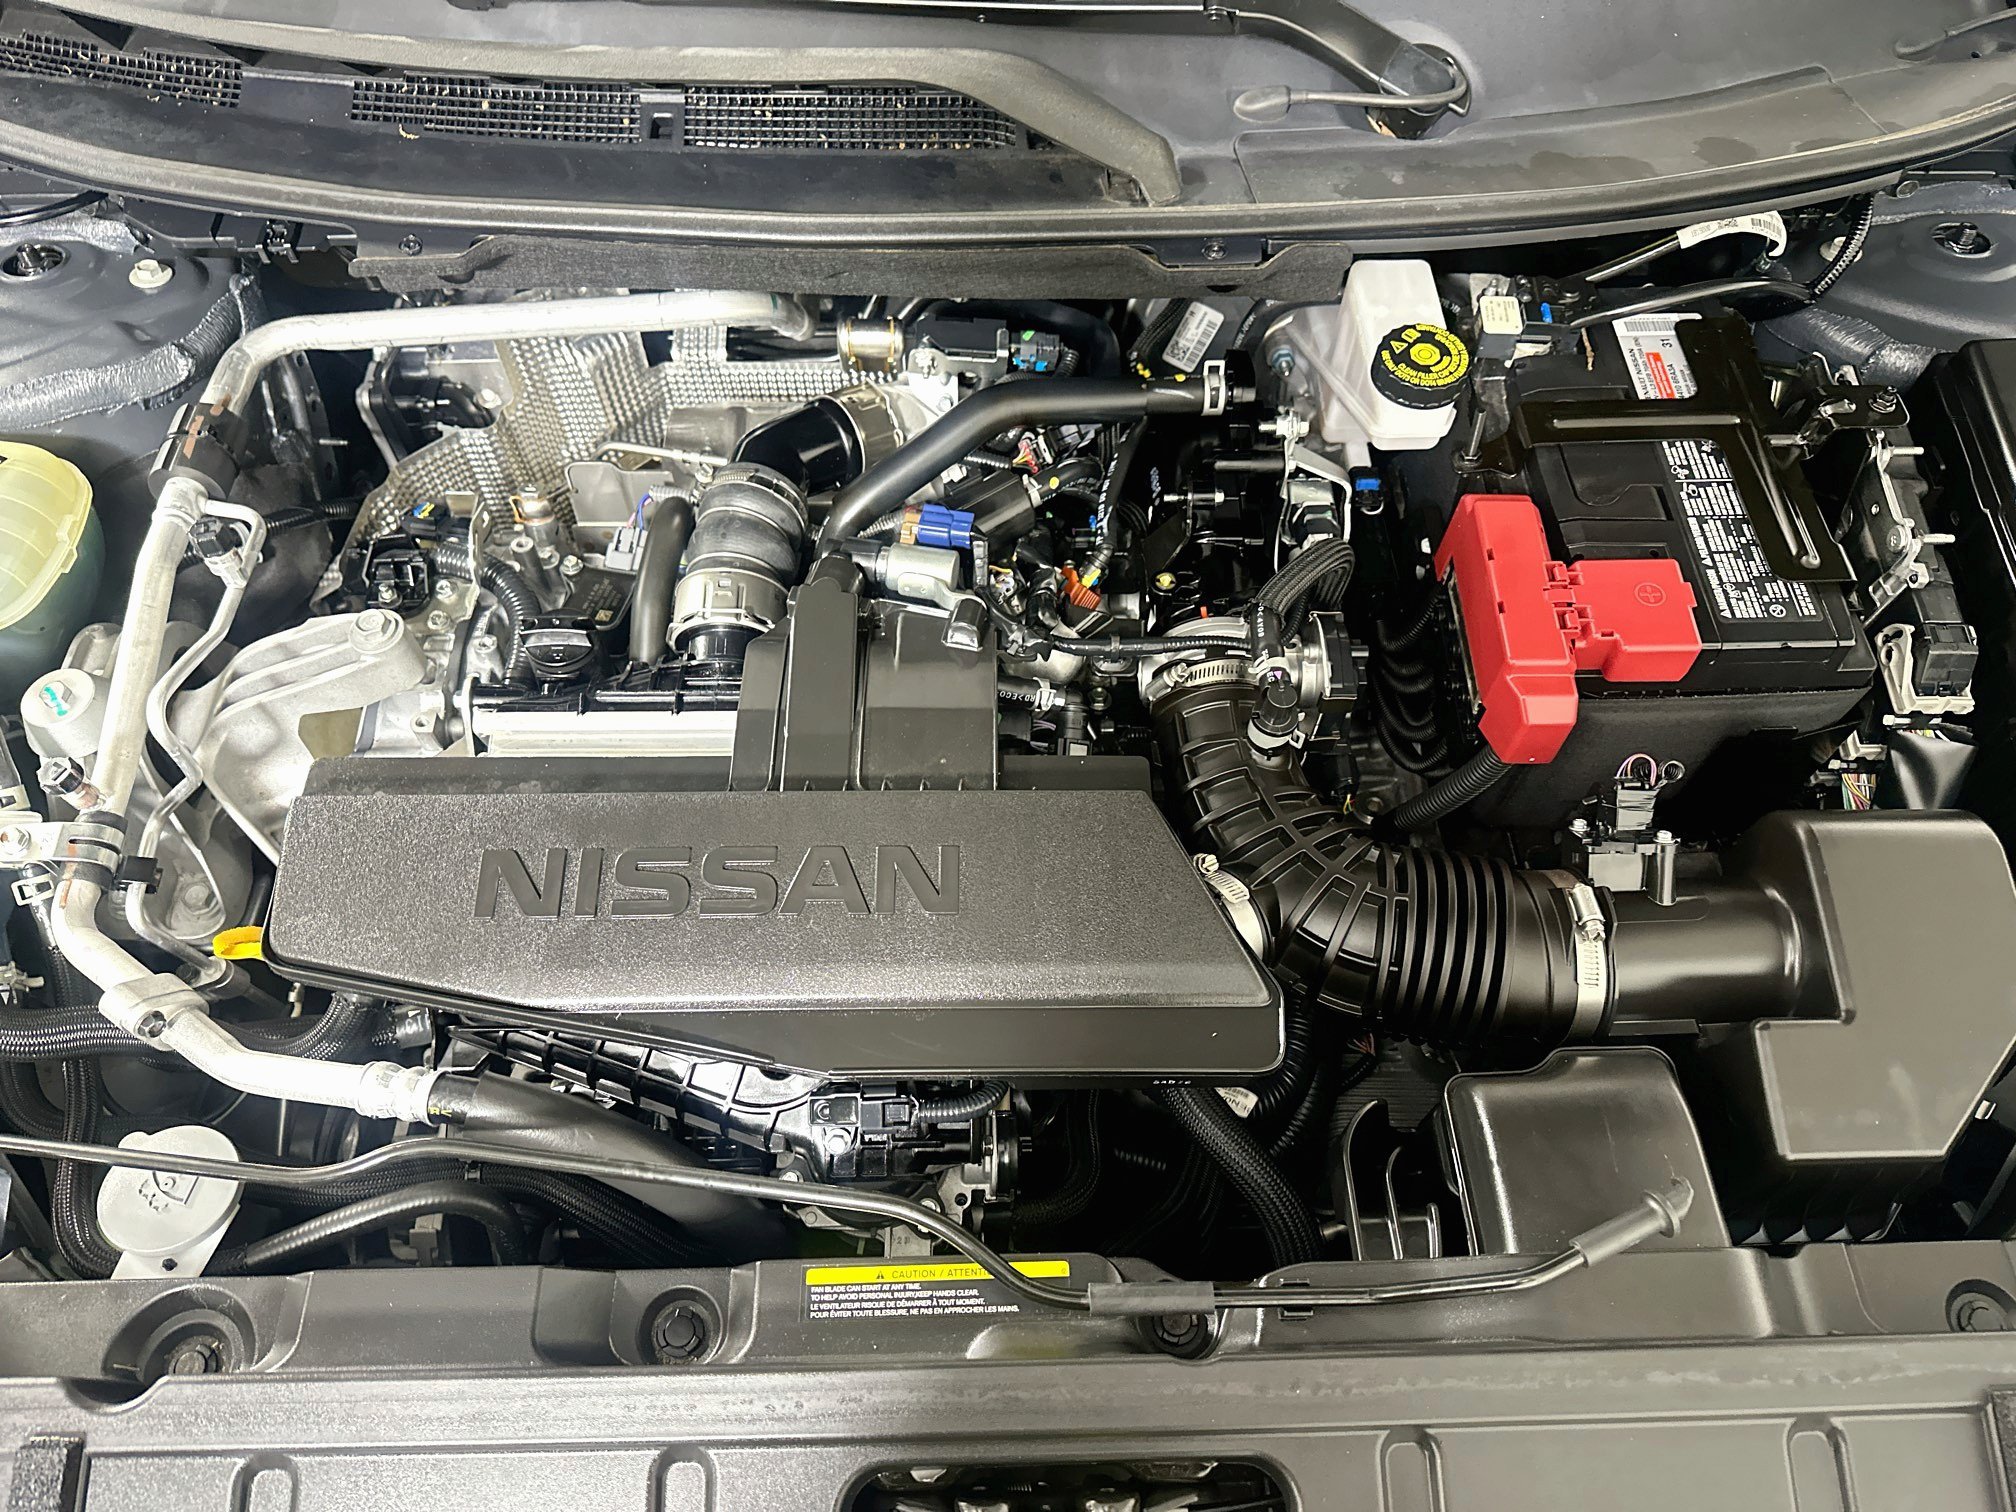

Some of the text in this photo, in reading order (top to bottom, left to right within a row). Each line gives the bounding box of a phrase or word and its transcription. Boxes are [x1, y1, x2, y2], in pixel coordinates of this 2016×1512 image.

[1660, 339, 1672, 348] 31
[1417, 371, 1439, 379] FILLER
[1628, 349, 1651, 399] ENAULT NISSAN
[474, 845, 960, 918] NISSAN
[892, 1269, 936, 1279] CAUTION
[947, 1267, 990, 1277] ATTENTI
[825, 1285, 846, 1293] BLADE
[891, 1283, 904, 1291] ANY
[859, 1292, 894, 1300] PERSONAL
[820, 1302, 860, 1310] VENTILATEUR
[861, 1301, 885, 1309] RISQUE
[896, 1299, 932, 1307] DÉMARRER
[932, 1298, 937, 1306] À
[938, 1298, 955, 1306] TOUT
[830, 1309, 852, 1318] ÉVITER
[874, 1308, 909, 1316] BLESSURE,
[920, 1307, 933, 1315] PAS
[944, 1306, 984, 1314] APPROCHER
